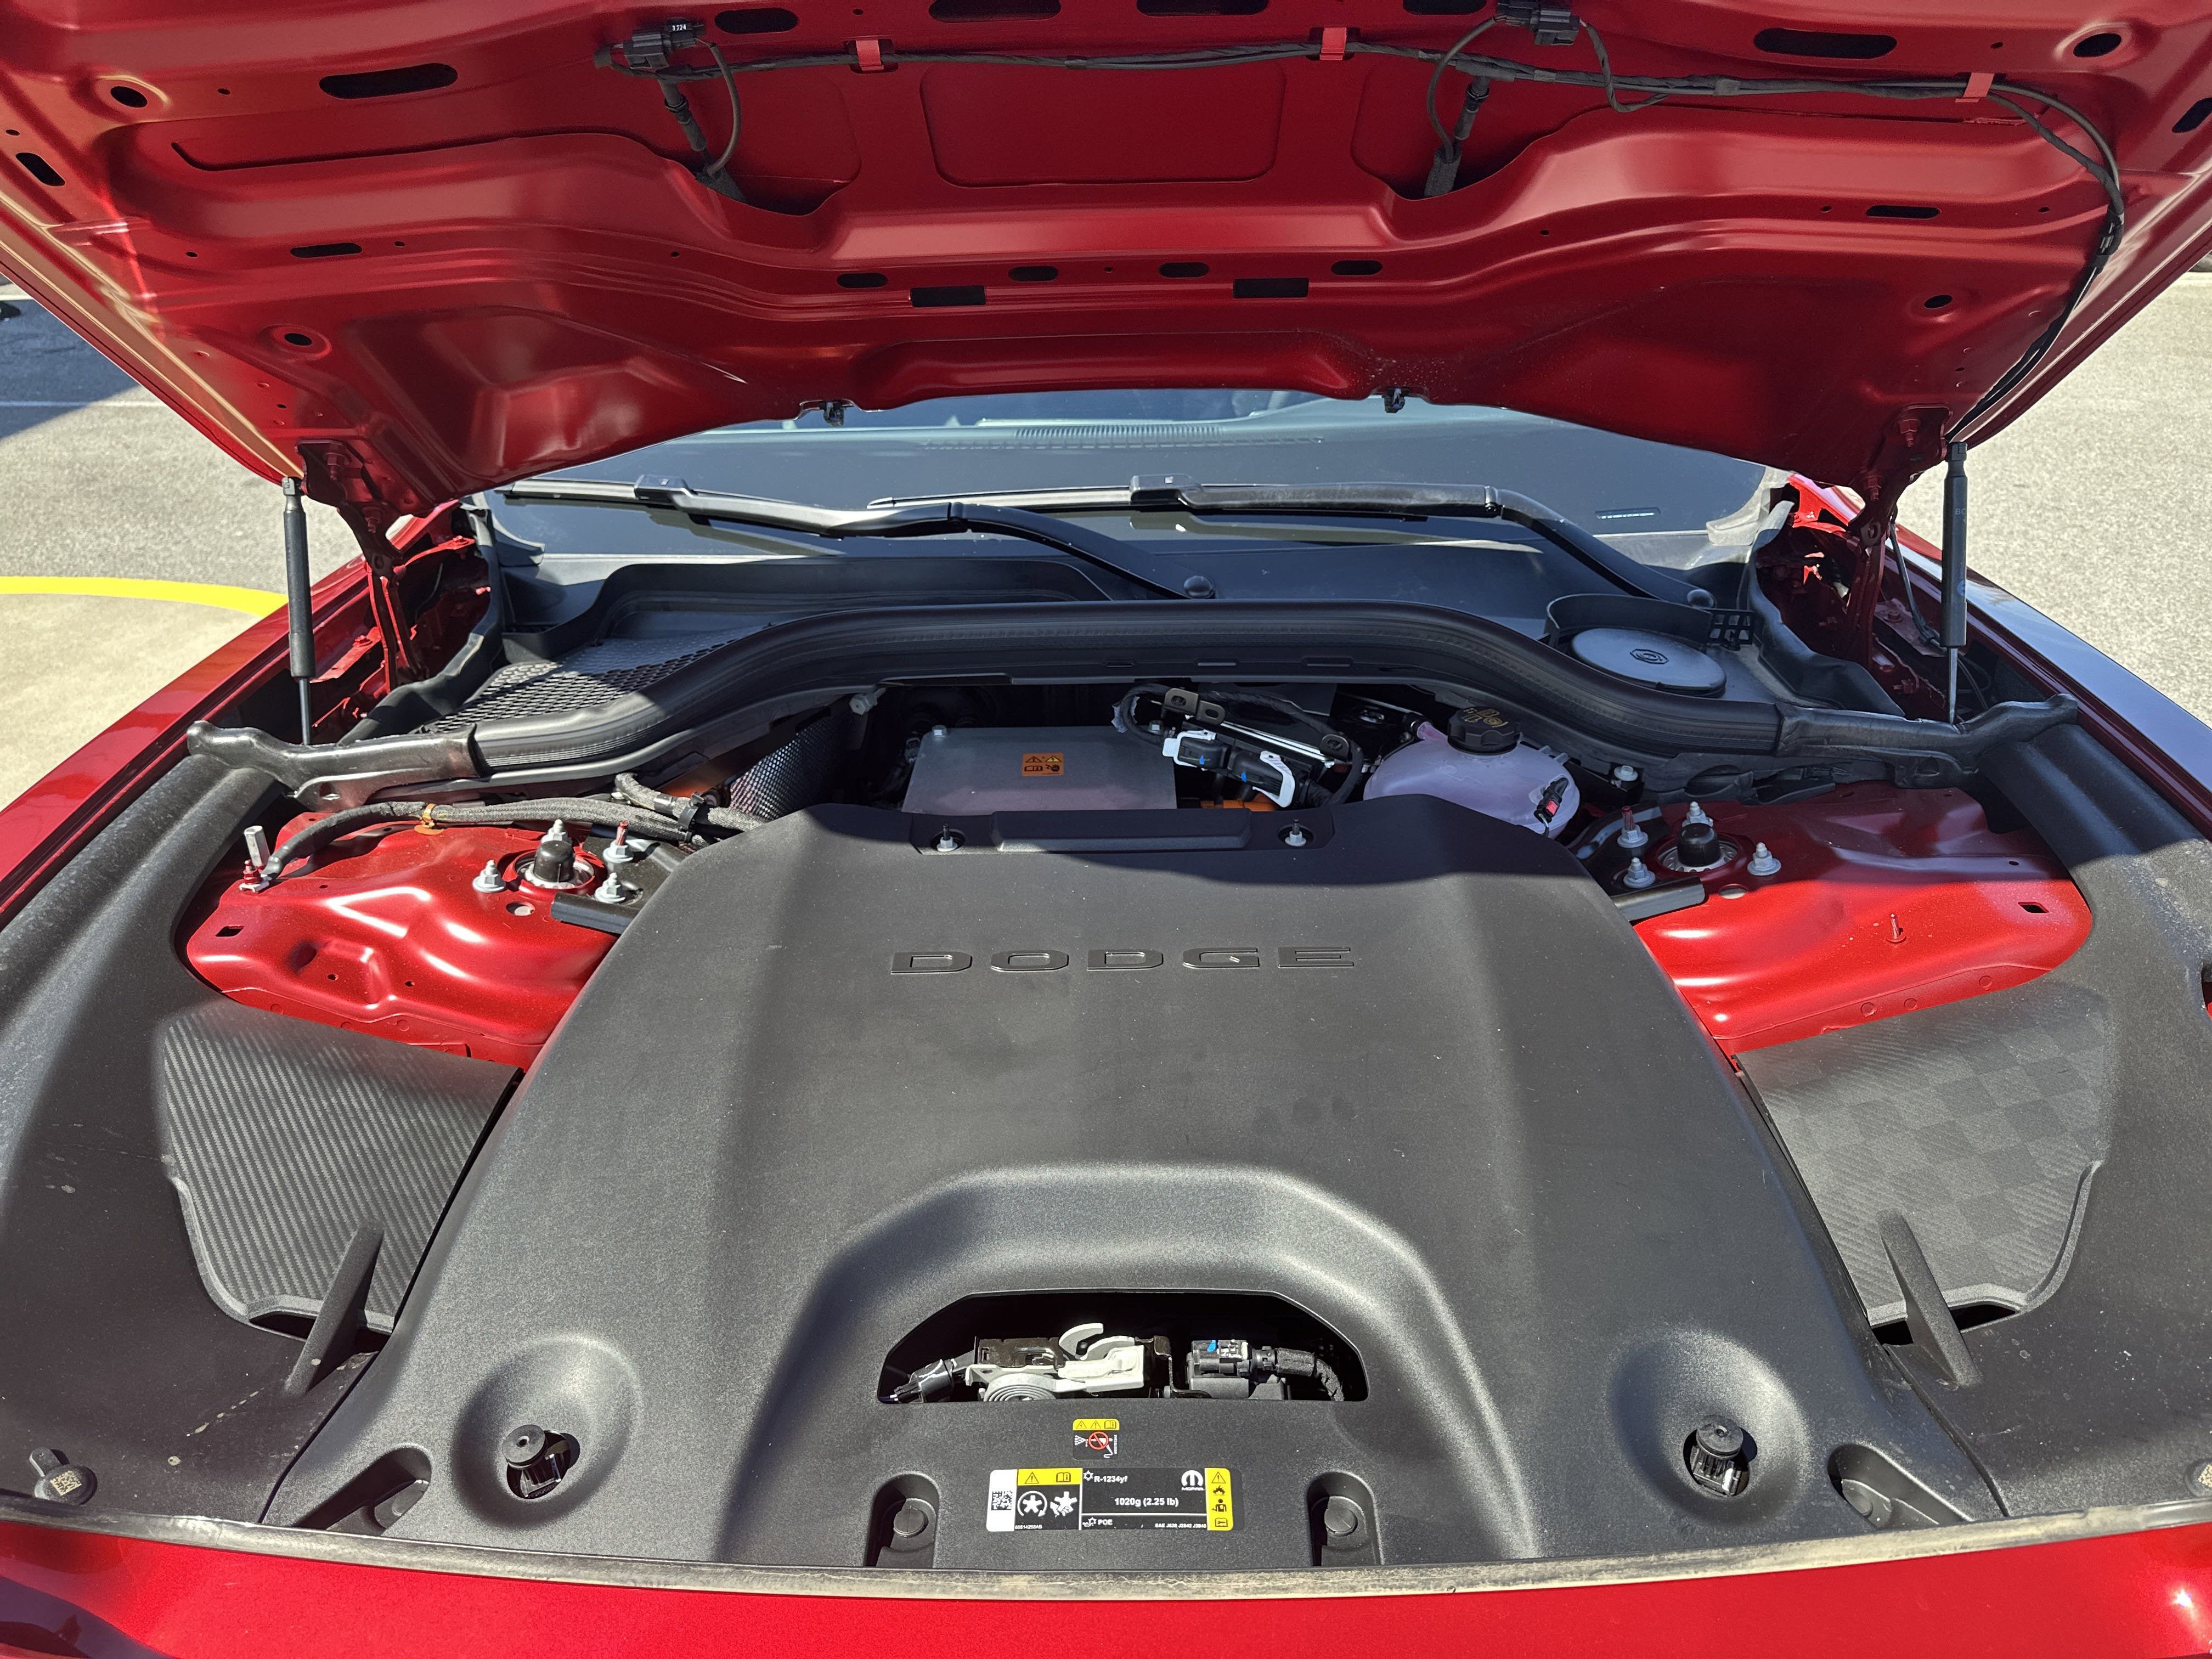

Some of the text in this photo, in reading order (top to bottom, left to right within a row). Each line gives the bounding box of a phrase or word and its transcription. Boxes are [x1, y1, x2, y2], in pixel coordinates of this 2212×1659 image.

[890, 946, 1355, 974] DODGE
[1094, 1475, 1128, 1483] R-1234yf
[1114, 1497, 1179, 1507] 1020g (2.25 lb)
